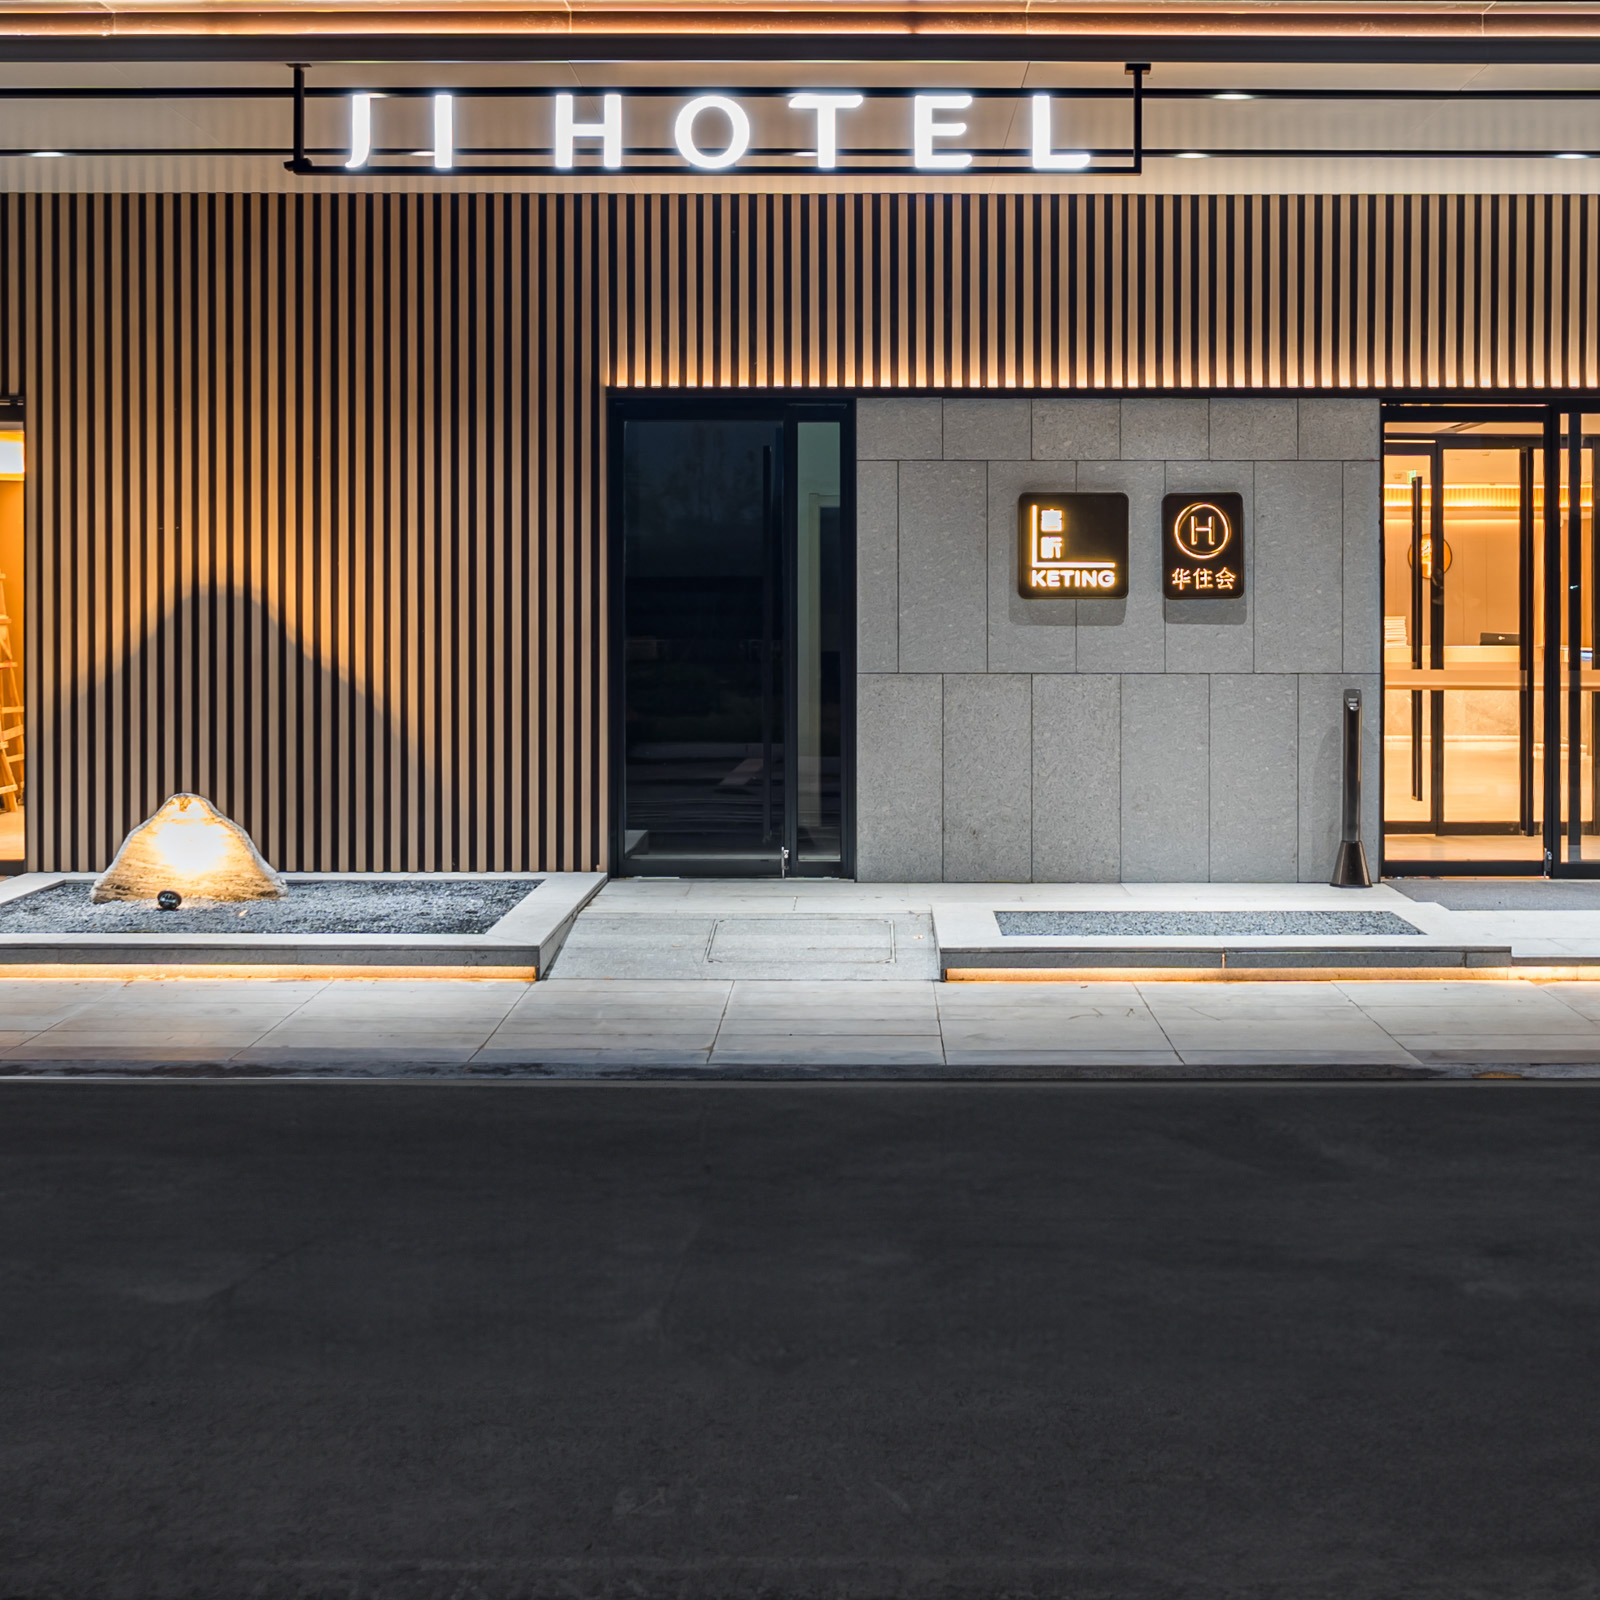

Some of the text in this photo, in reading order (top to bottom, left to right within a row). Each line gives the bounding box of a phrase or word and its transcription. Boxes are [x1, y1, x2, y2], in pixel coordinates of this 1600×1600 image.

[345, 94, 1091, 169] JI HOTEL
[1031, 569, 1116, 588] KETING
[1171, 566, 1237, 591] 华住会
